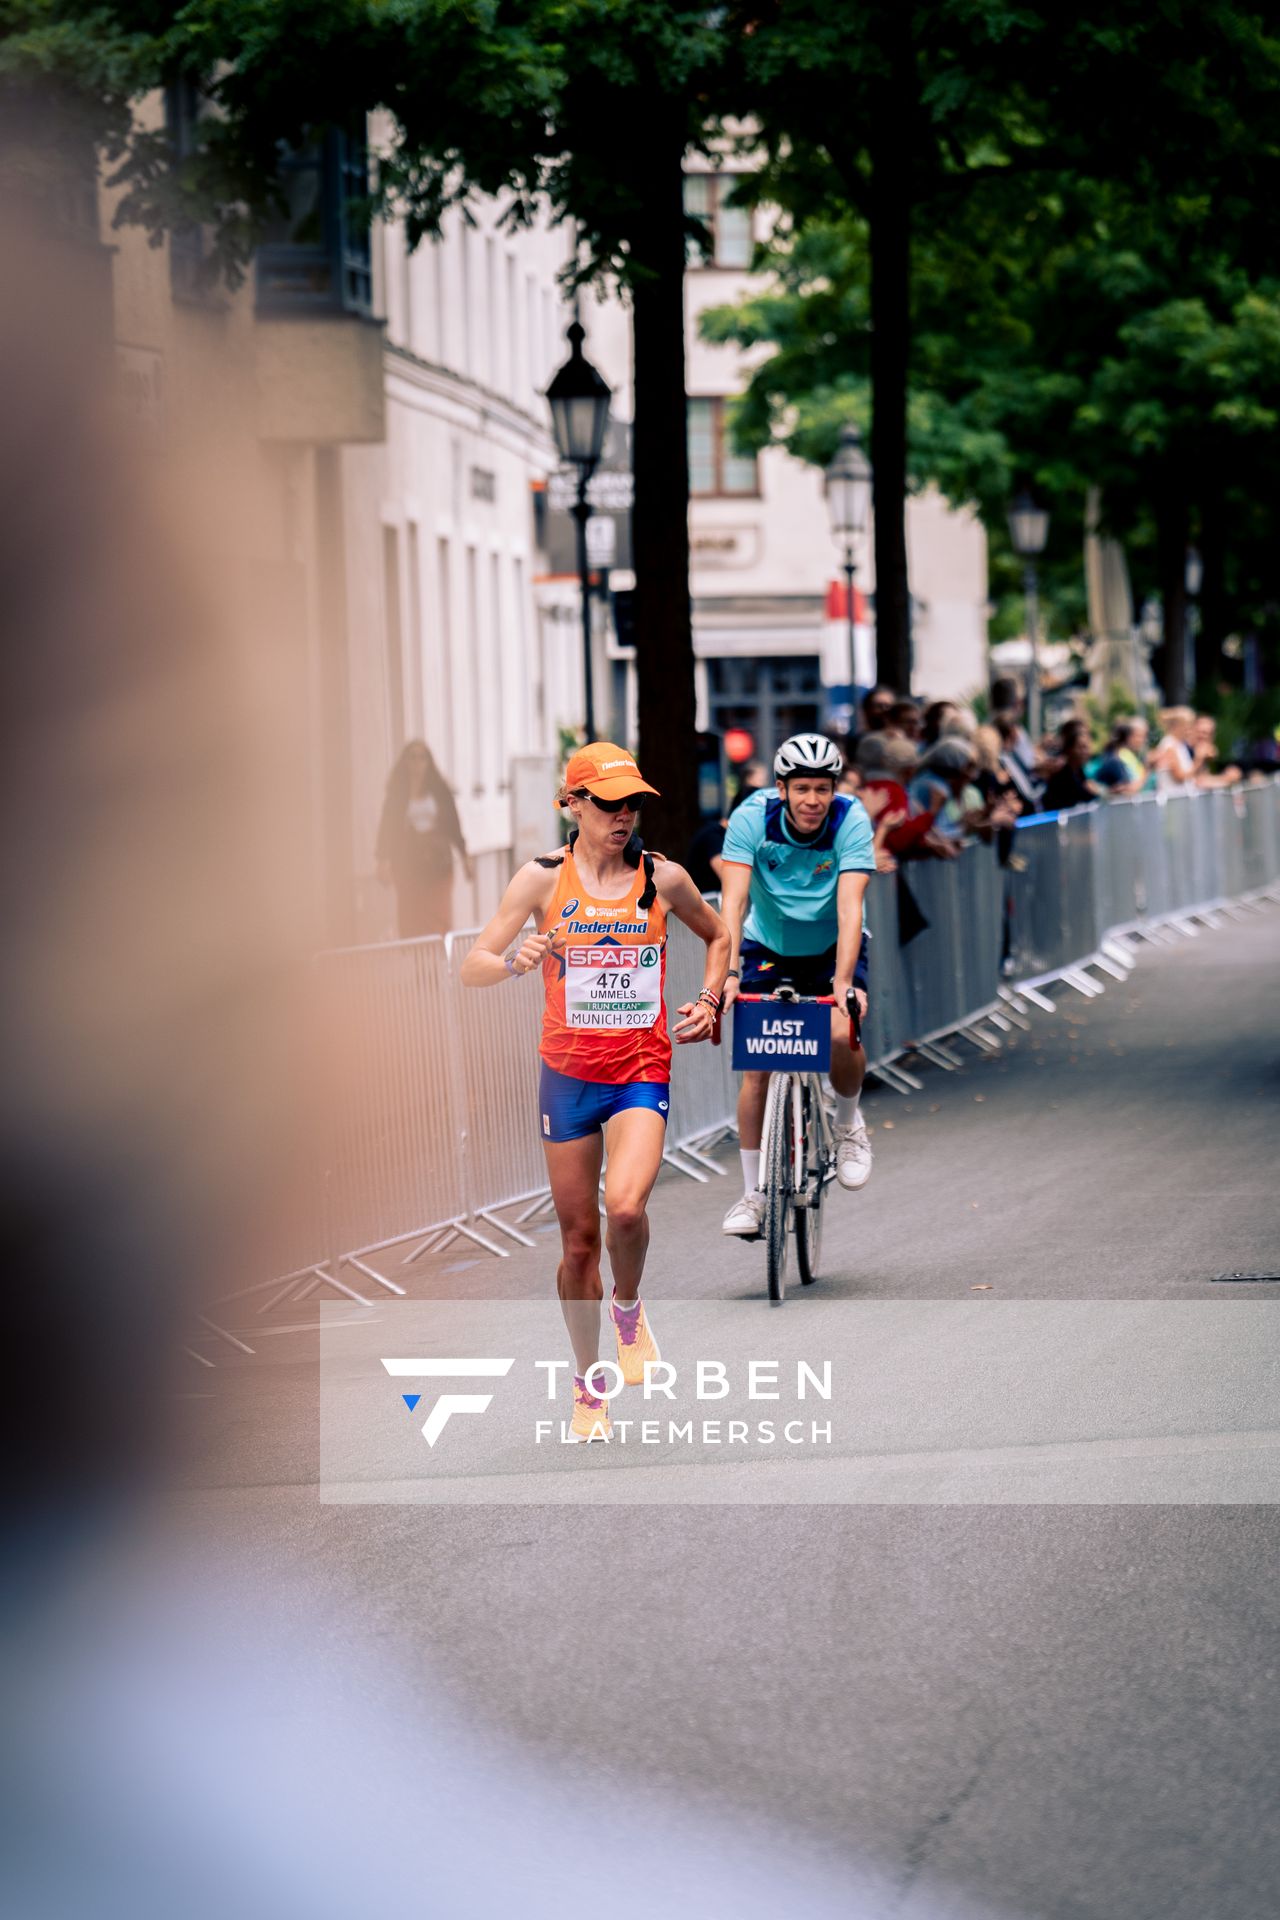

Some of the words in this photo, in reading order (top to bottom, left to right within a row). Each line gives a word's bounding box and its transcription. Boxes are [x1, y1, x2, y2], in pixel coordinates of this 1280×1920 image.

[570, 950, 637, 966] SPAR
[596, 973, 631, 989] 476
[591, 990, 637, 999] UMMELS
[592, 1003, 610, 1011] RUN
[572, 1013, 622, 1025] MUNICH
[626, 1013, 656, 1025] 2022
[762, 1019, 804, 1036] LAST
[746, 1038, 818, 1056] WOMAN
